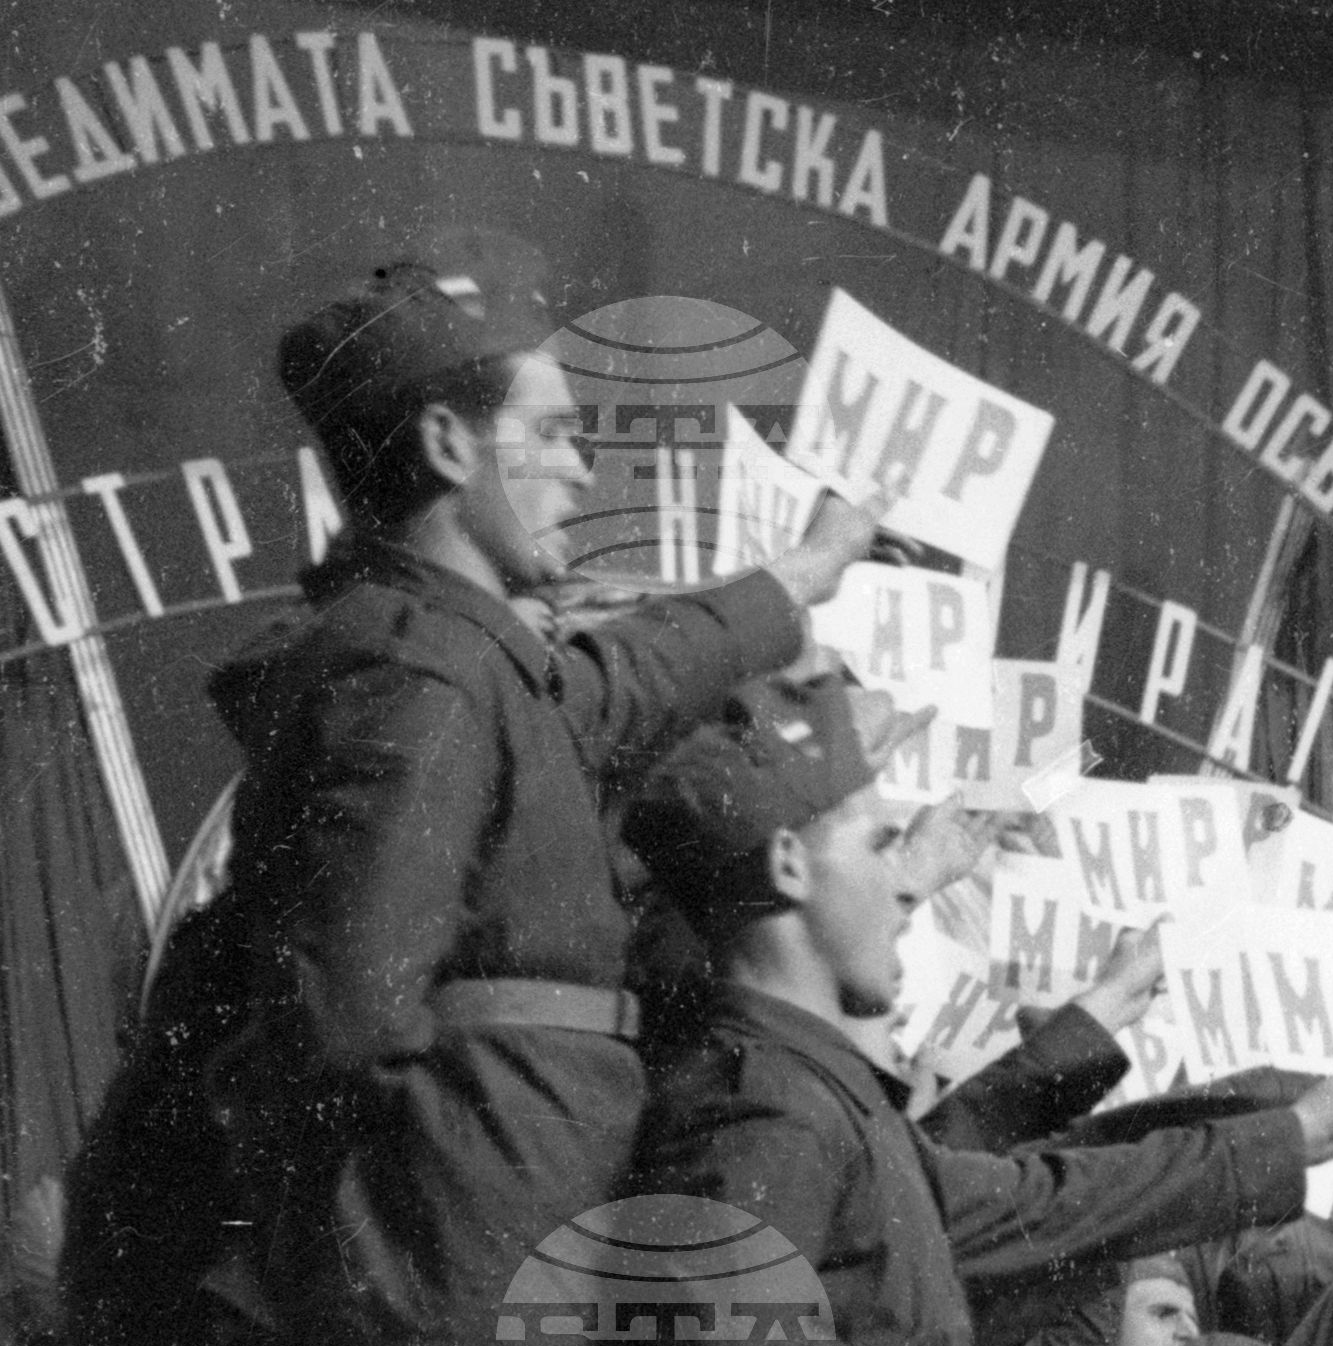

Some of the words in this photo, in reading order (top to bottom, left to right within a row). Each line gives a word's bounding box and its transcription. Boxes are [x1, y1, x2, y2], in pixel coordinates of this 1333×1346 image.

[0, 33, 412, 217] ЕДИМАТА
[472, 36, 891, 228] СЪВЕТСКА
[939, 173, 1200, 386] АРМИЯ
[808, 350, 1017, 501] МИР
[0, 447, 345, 646] СТРА
[867, 581, 966, 681] ИР
[1069, 797, 1217, 910] МИР
[1004, 894, 1116, 994] МИ
